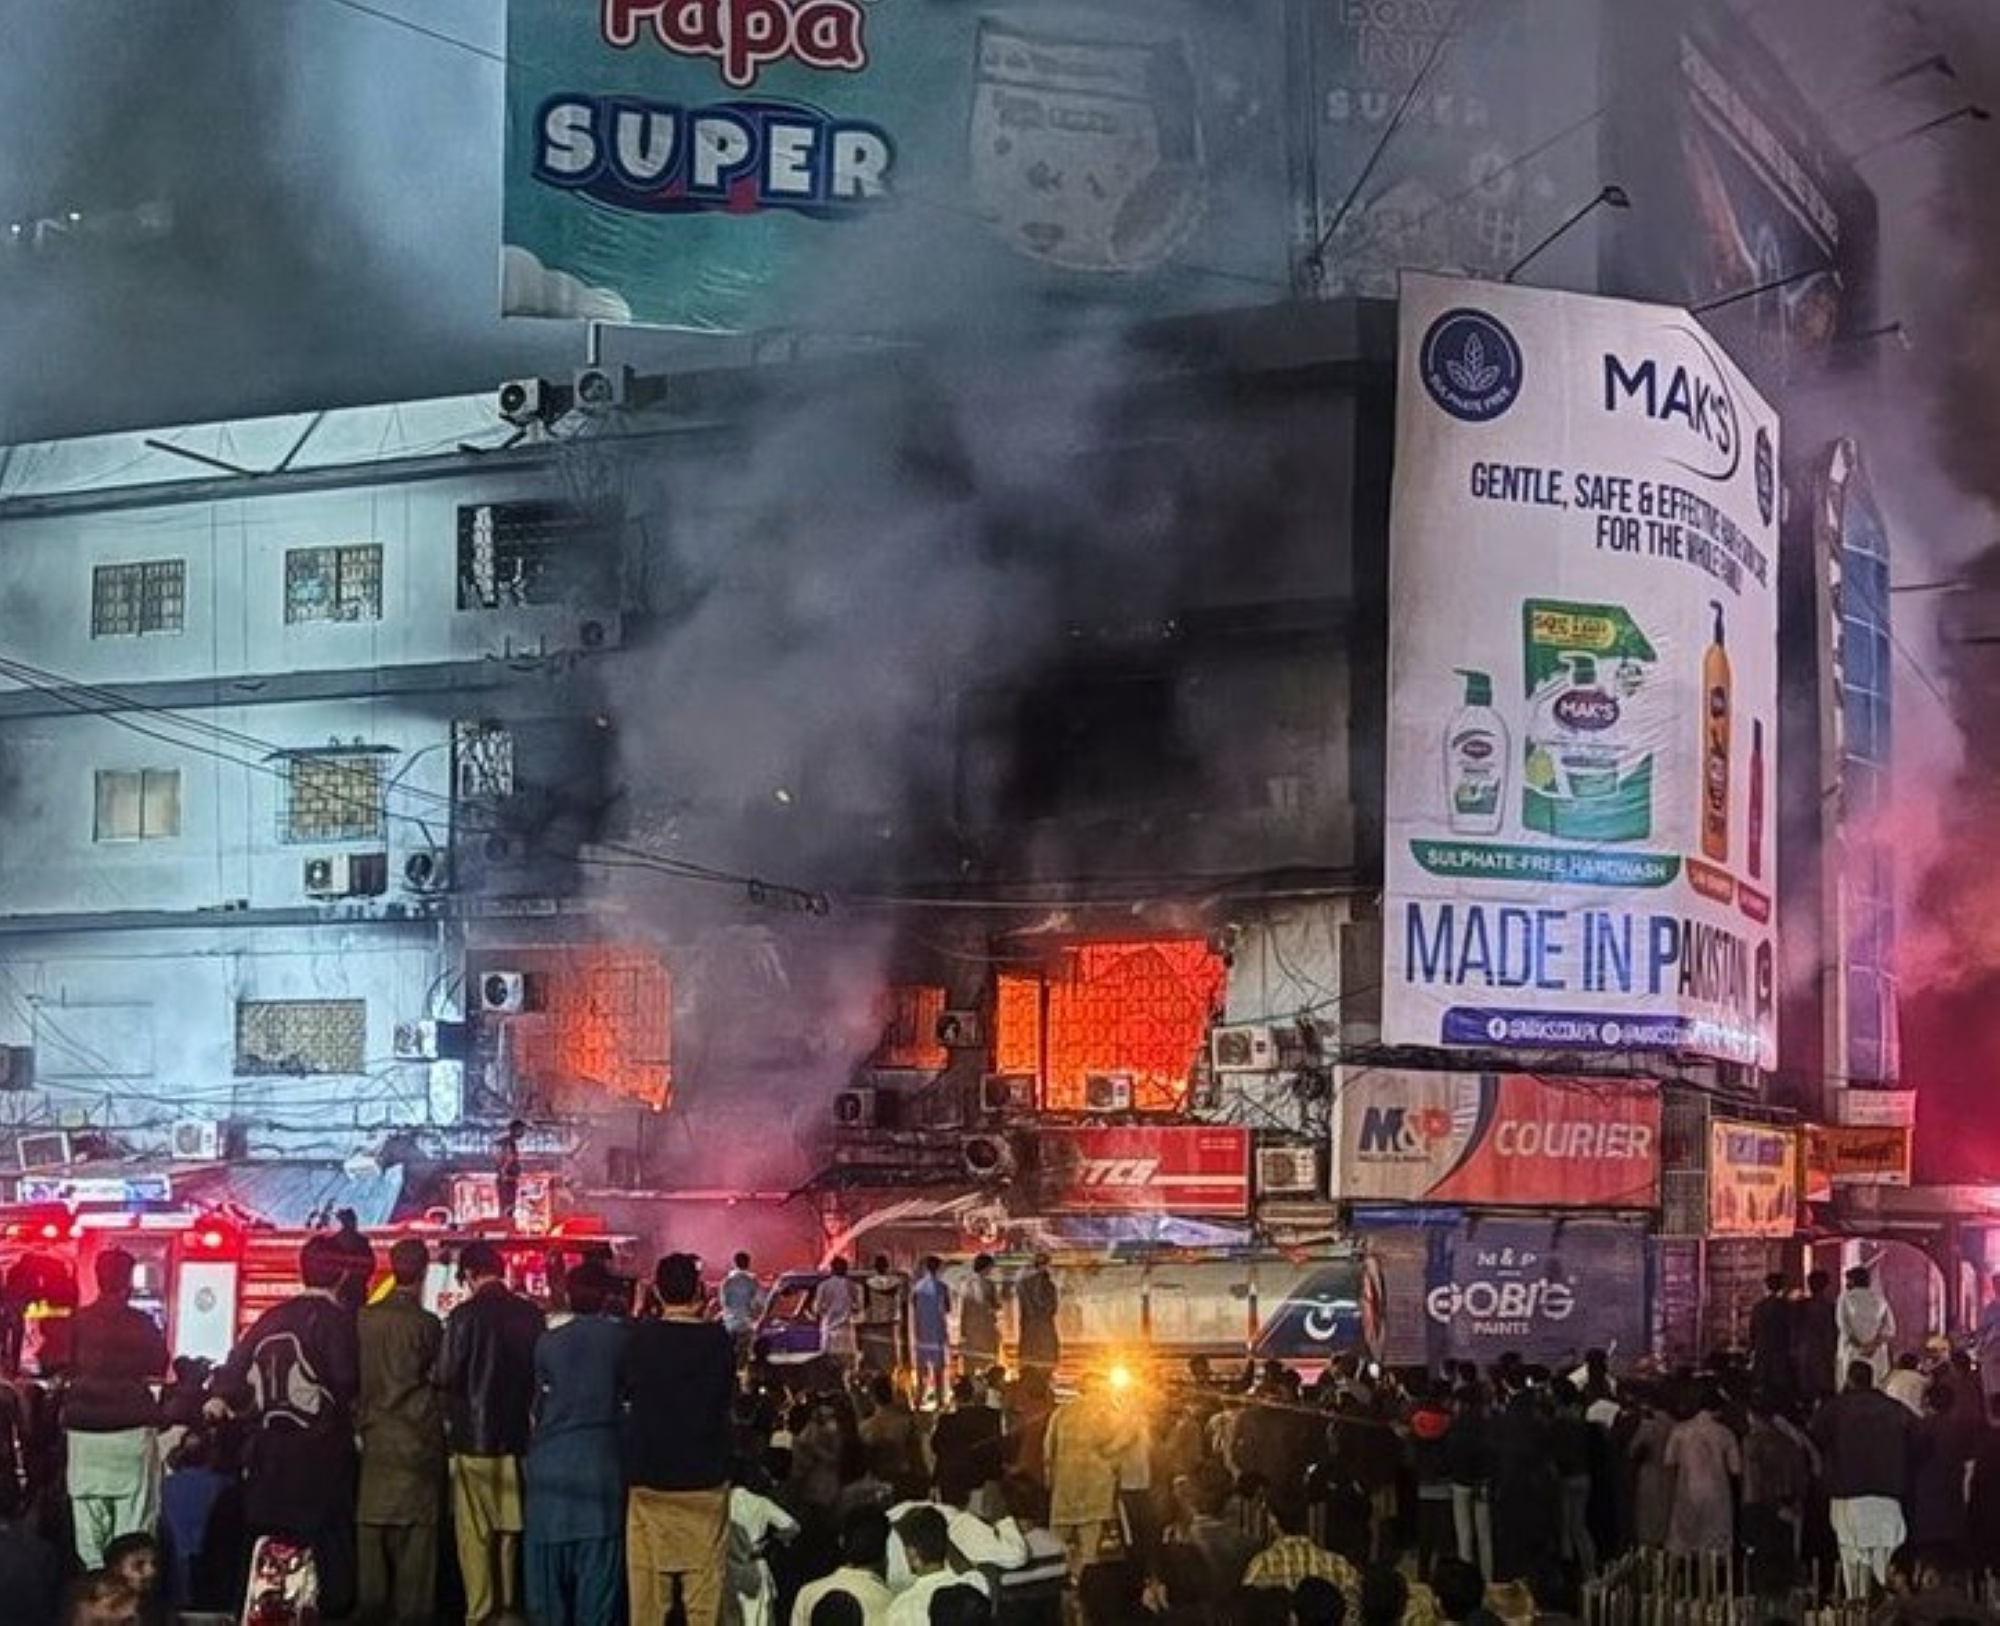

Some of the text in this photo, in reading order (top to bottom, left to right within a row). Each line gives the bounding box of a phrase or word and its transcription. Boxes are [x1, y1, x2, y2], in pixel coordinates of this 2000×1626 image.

[542, 101, 890, 200] SUPER
[1471, 461, 1568, 510] GENTLE,
[1574, 473, 1633, 513] SAFE
[1638, 481, 1652, 516] &
[1596, 515, 1641, 553] FOR
[1646, 520, 1684, 560] THE
[1405, 901, 1567, 990] MADE
[1583, 912, 1631, 993] IN
[1494, 1119, 1651, 1159] COURIER
[1473, 1322, 1530, 1335] PAINTS
